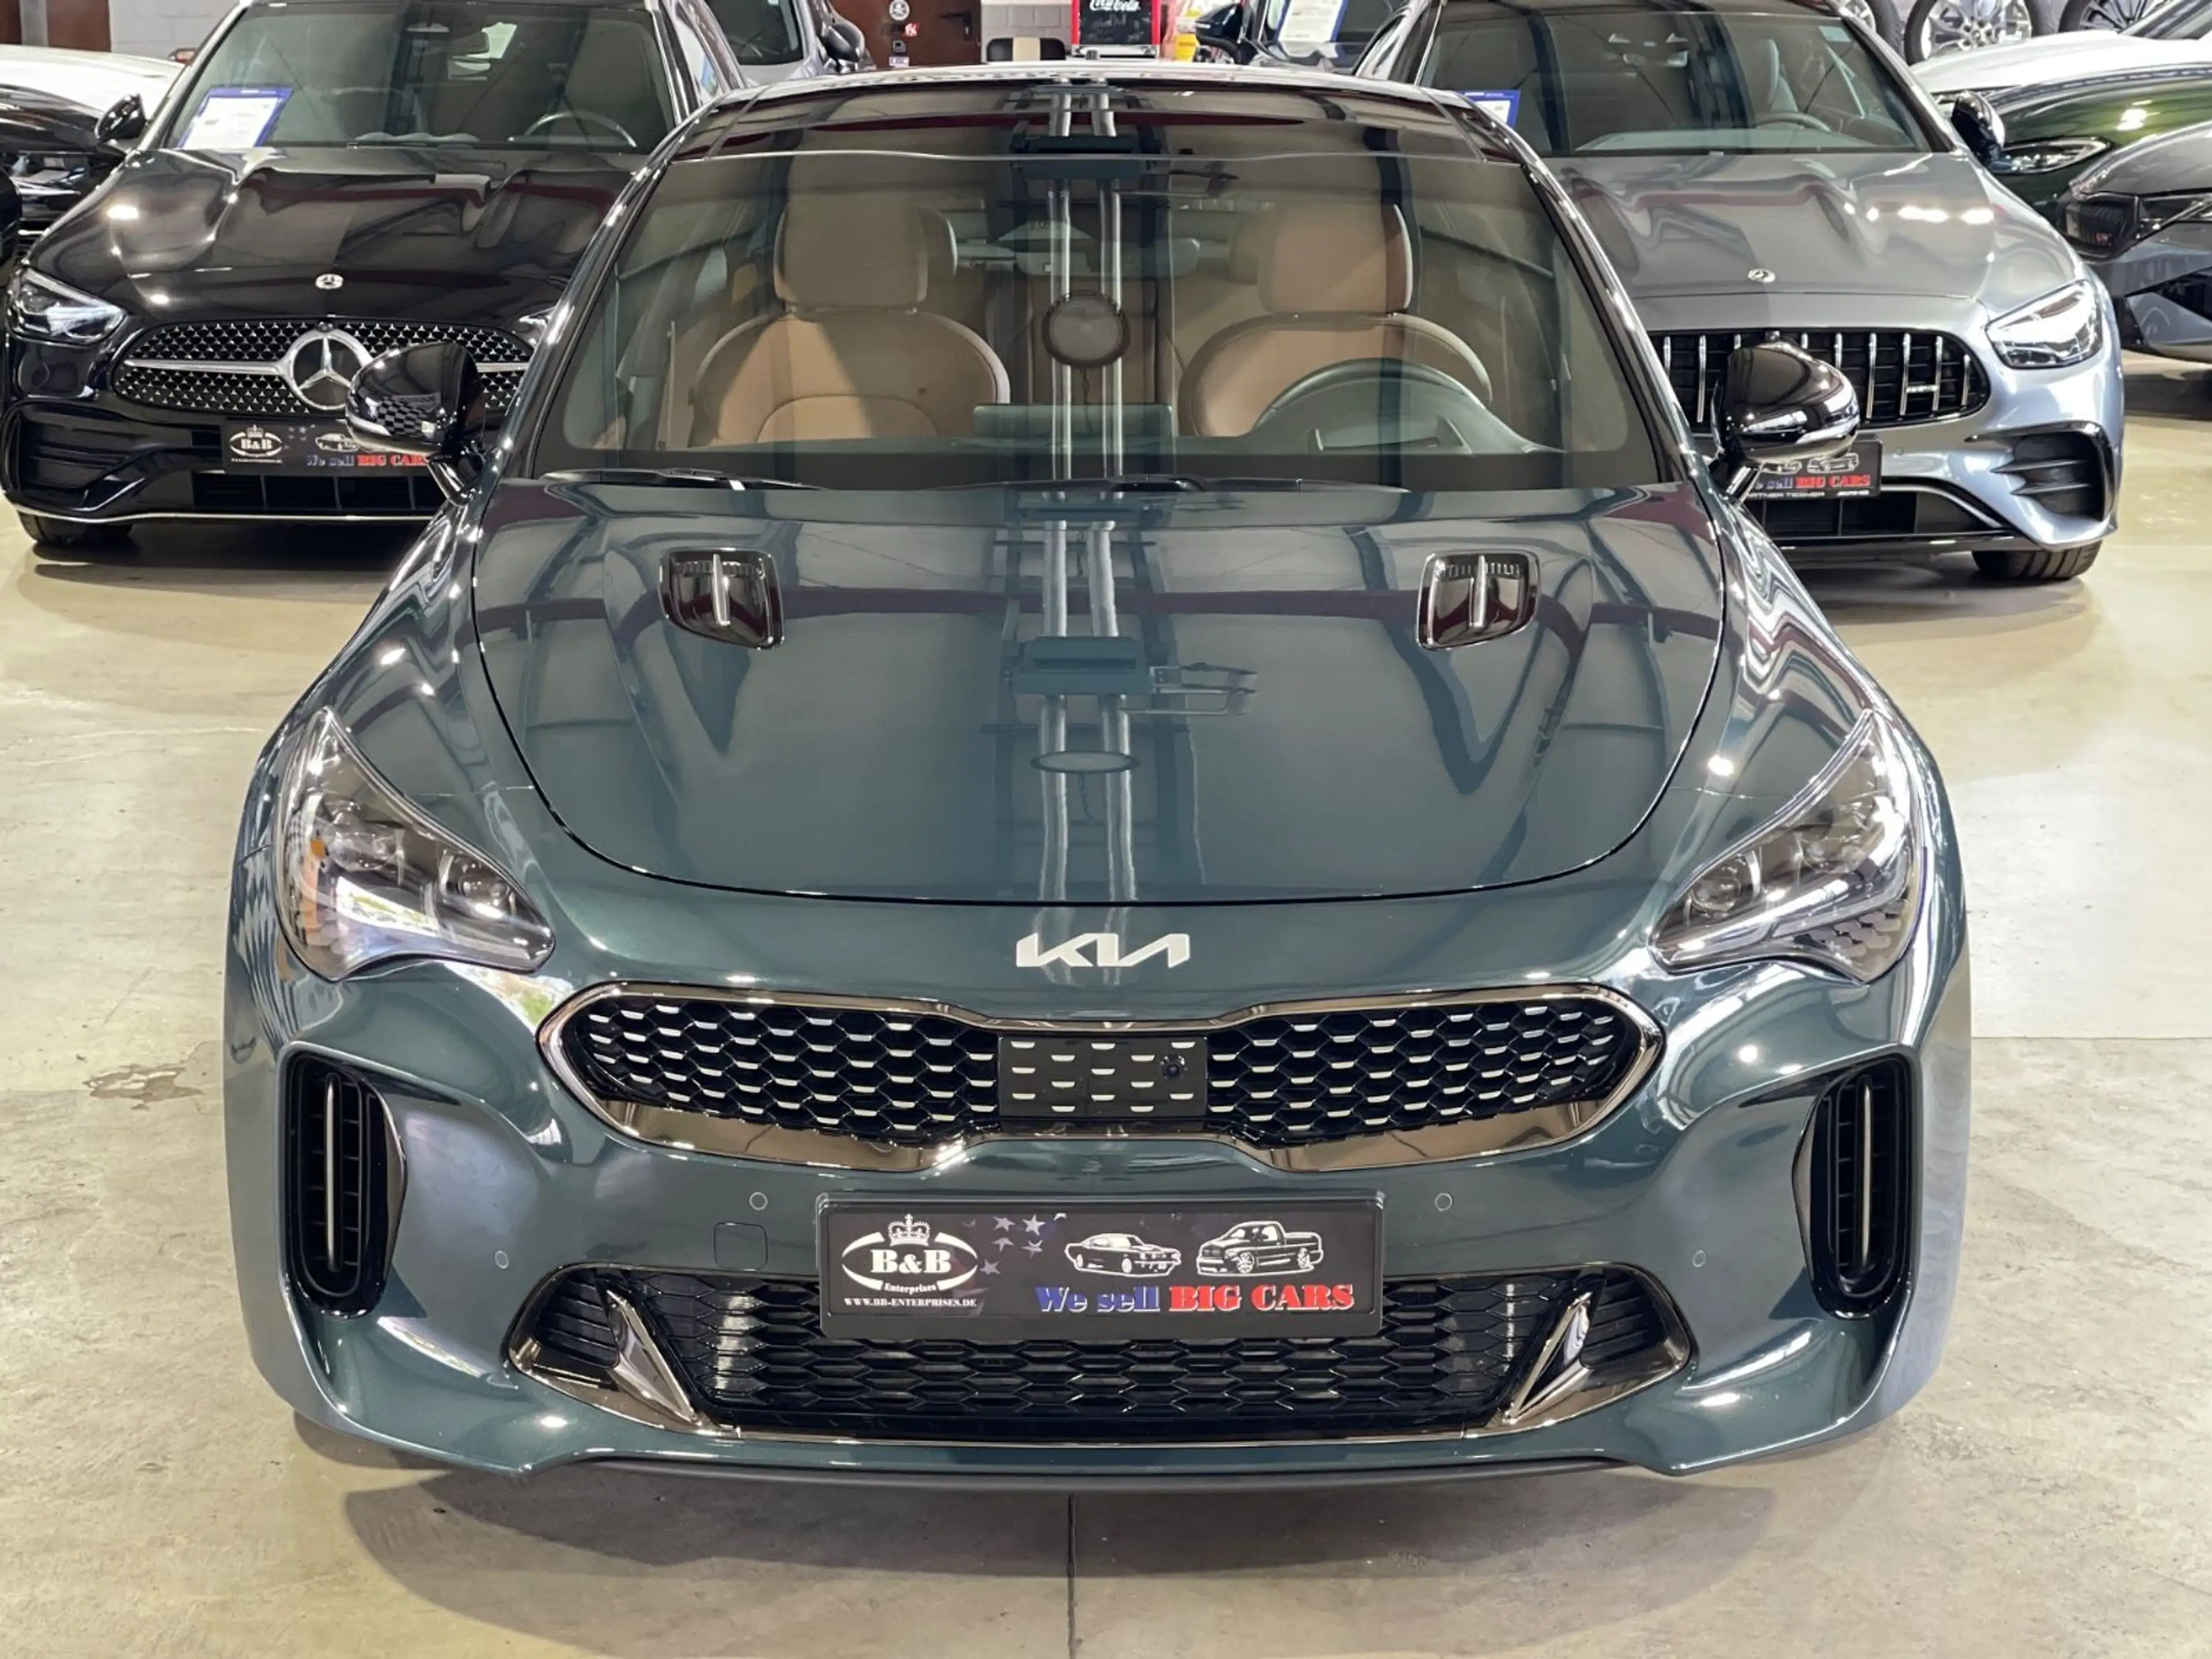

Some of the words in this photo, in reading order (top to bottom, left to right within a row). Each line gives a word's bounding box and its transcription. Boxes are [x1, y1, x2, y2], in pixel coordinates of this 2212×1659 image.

[357, 454, 386, 466] BIG
[389, 454, 427, 466] CAR
[1796, 476, 1825, 488] BIG
[1829, 475, 1870, 487] CARS
[870, 1249, 952, 1274] B&B
[884, 1282, 938, 1296] Enterprises
[844, 1297, 978, 1307] WWW.BB-ENTERPRISES.DE
[1035, 1285, 1088, 1312] We
[1097, 1285, 1161, 1312] sell
[1169, 1285, 1242, 1312] BIG
[1251, 1284, 1355, 1311] CARS
